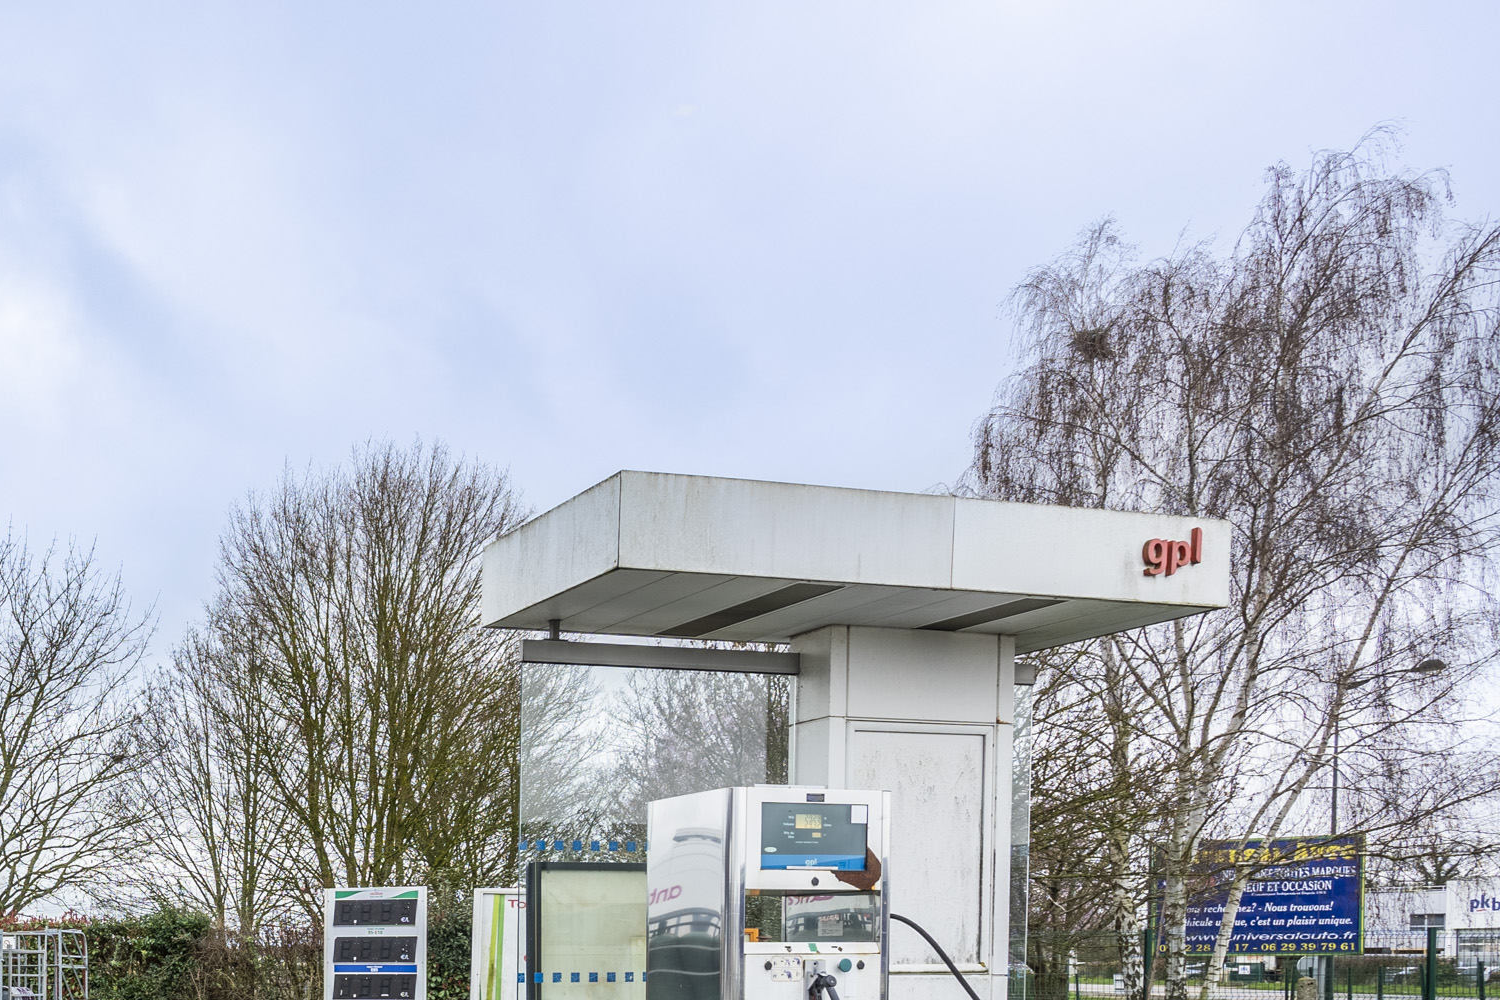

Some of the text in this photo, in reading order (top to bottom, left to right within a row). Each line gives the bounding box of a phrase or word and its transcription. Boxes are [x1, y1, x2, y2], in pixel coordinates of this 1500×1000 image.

[1142, 527, 1202, 577] gpl
[1243, 882, 1266, 892] EUF
[1267, 882, 1280, 892] ET
[1264, 902, 1288, 912] Nous
[1290, 901, 1334, 912] trouvons!
[1250, 916, 1271, 926] c'est
[1286, 915, 1316, 927] plaisir
[1318, 916, 1353, 926] unique.
[1261, 943, 1276, 951] 06
[1300, 942, 1316, 950] 39
[1320, 942, 1336, 950] 79
[1340, 942, 1356, 950] 61
